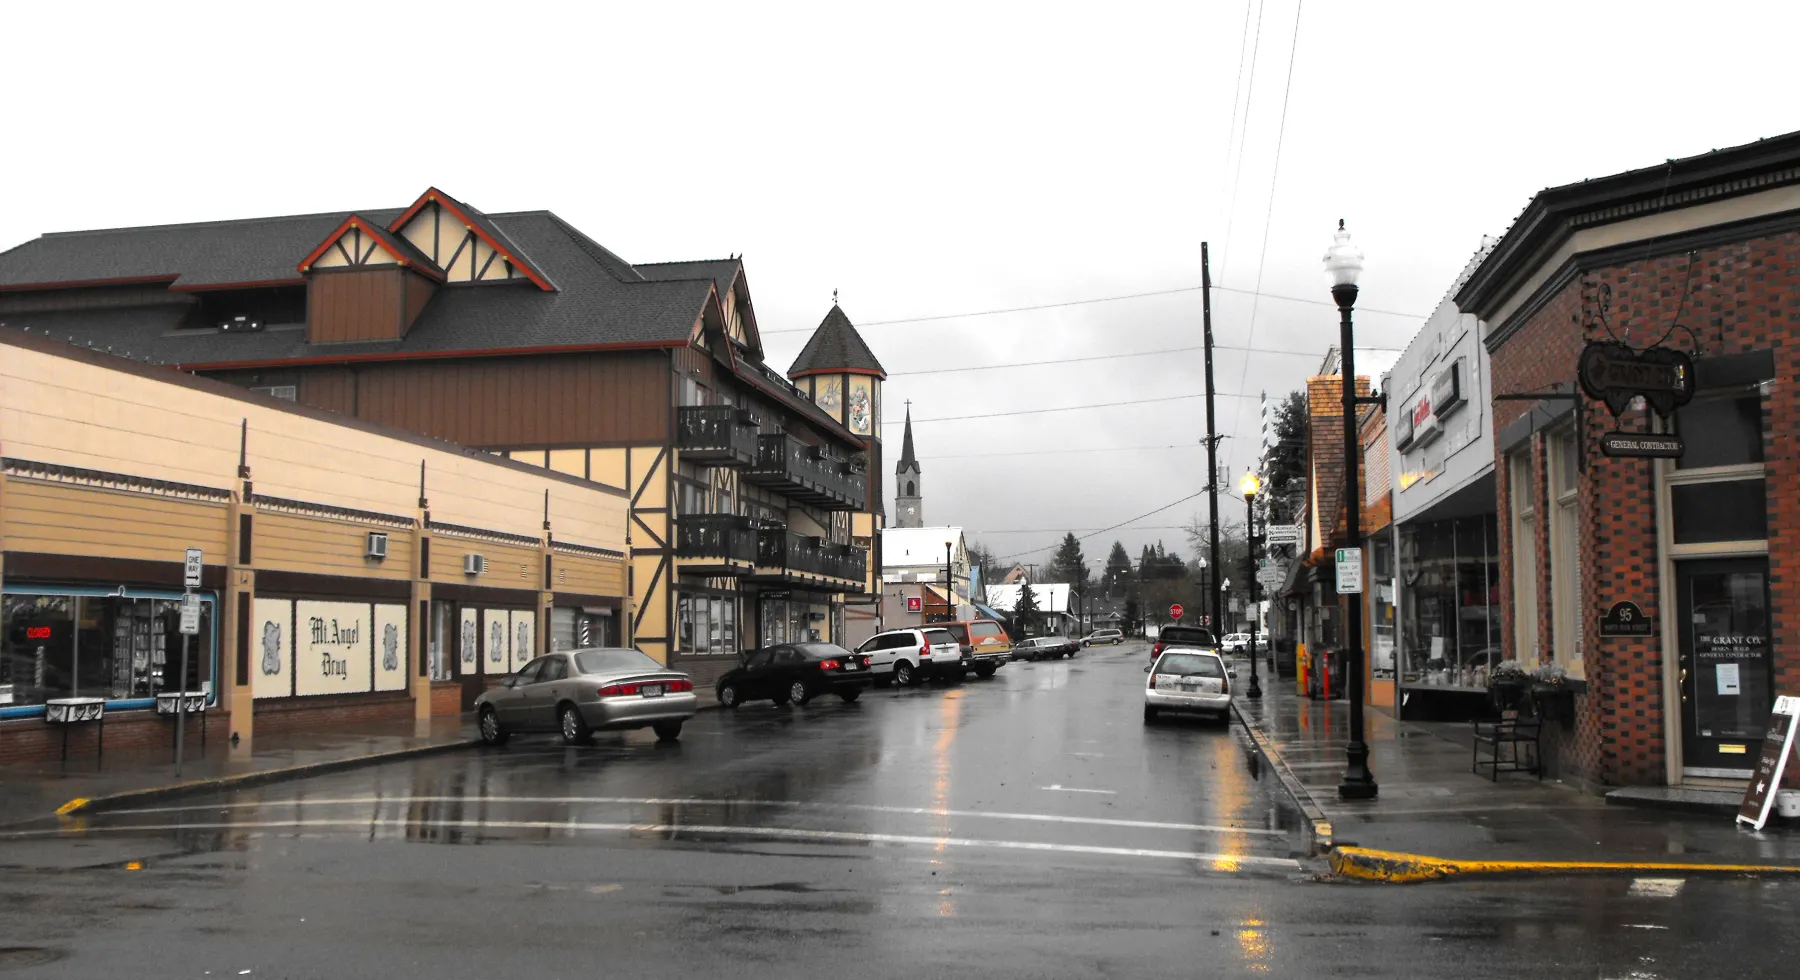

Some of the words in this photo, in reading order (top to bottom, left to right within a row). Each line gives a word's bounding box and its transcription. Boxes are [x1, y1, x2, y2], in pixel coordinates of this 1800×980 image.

[1610, 440, 1639, 449] GENERAL
[1640, 441, 1678, 450] CONTRACTOR
[188, 556, 200, 564] ONE
[187, 565, 199, 573] WAY
[1619, 608, 1632, 622] 95
[330, 618, 360, 650] Angel
[1712, 636, 1745, 645] GRANT
[1746, 635, 1761, 645] CO.
[321, 652, 347, 680] Drug
